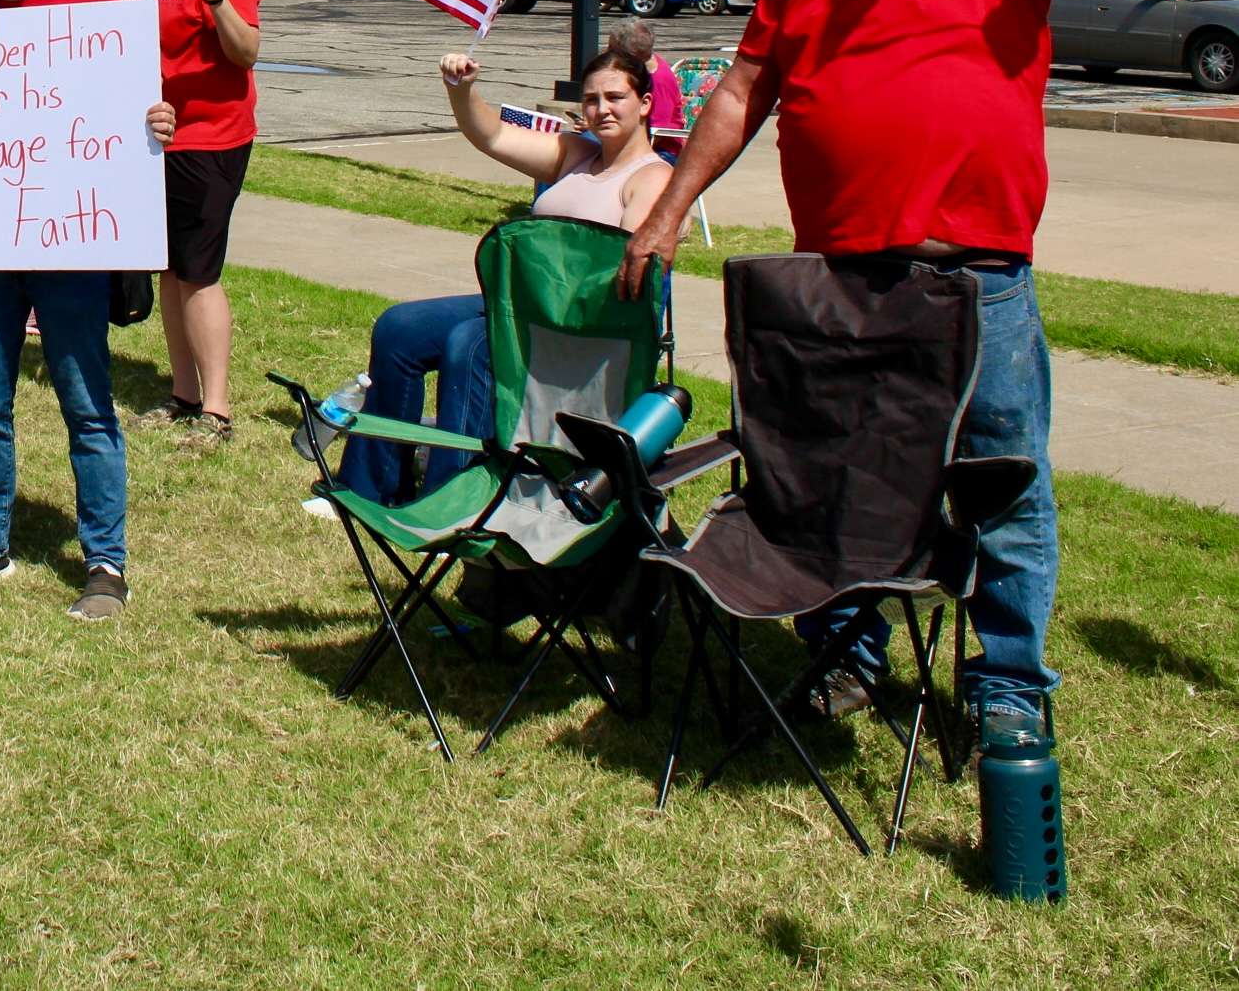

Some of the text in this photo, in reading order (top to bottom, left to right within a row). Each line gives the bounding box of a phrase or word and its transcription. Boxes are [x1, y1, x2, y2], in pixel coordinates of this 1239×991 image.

[48, 5, 123, 68] Him
[23, 72, 63, 110] his
[66, 116, 123, 161] for
[14, 187, 119, 248] Faith
